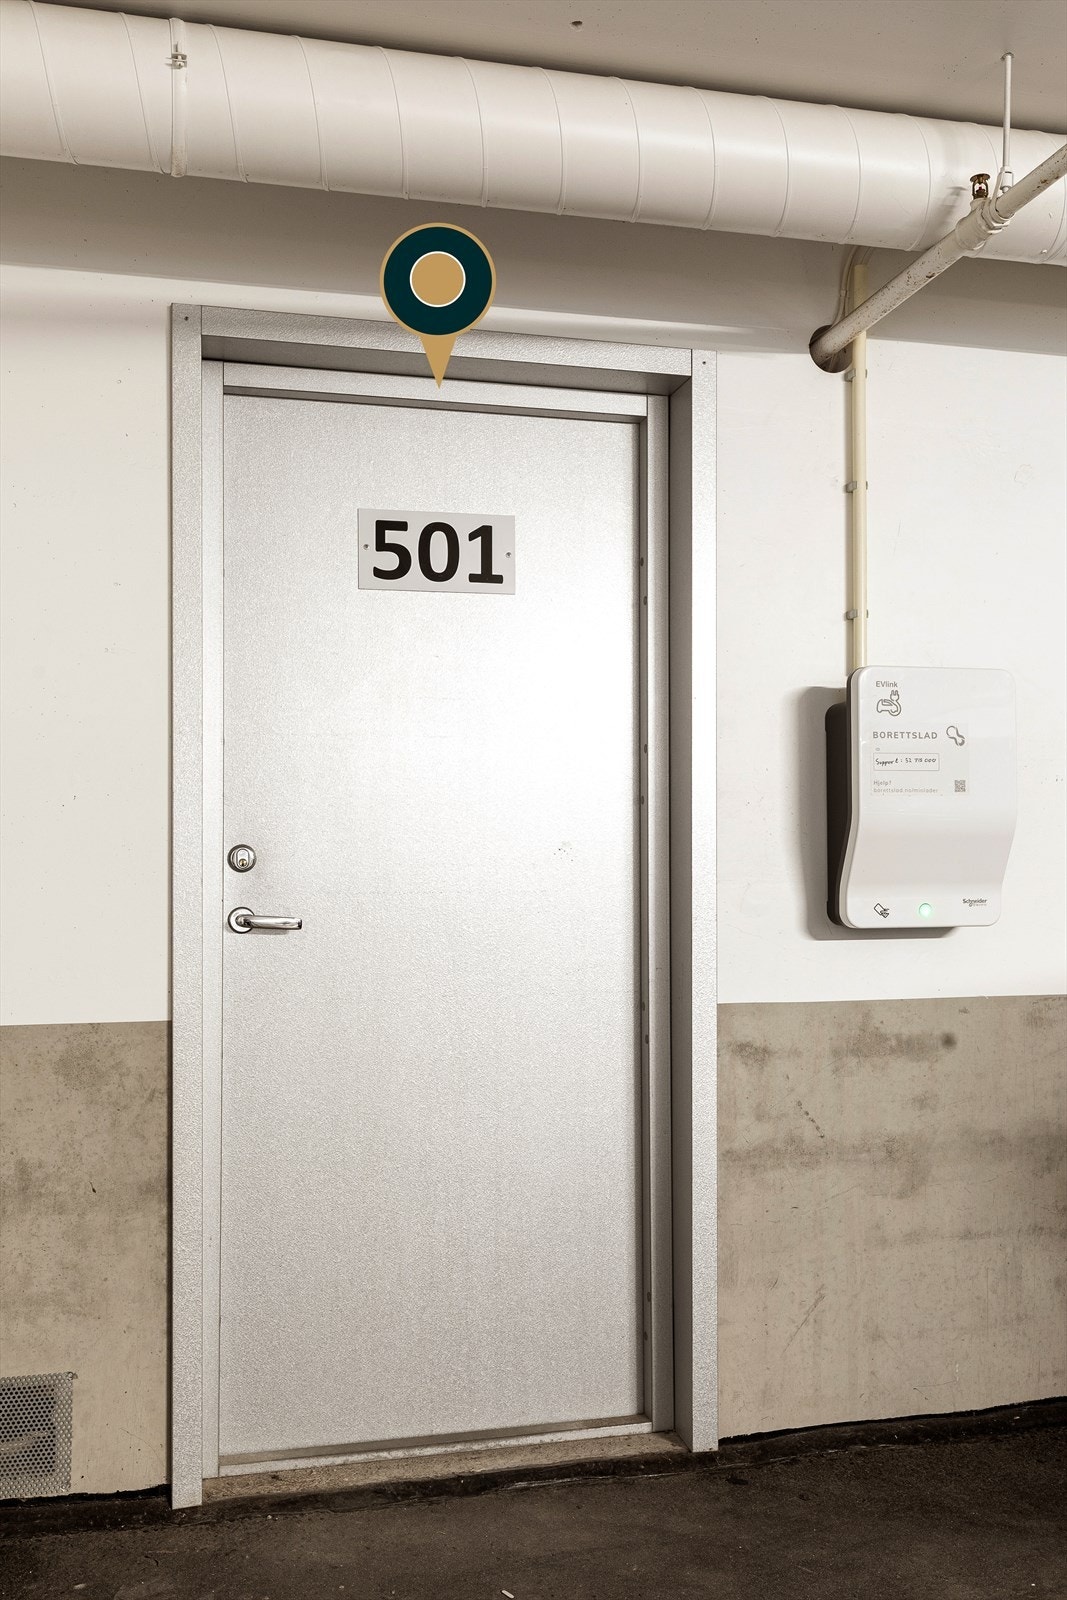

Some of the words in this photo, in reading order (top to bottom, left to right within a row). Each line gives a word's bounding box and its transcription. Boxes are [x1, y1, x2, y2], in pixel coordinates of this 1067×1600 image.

[373, 519, 504, 584] 501
[875, 680, 898, 688] EVlink
[872, 731, 938, 740] BORETTSLAD
